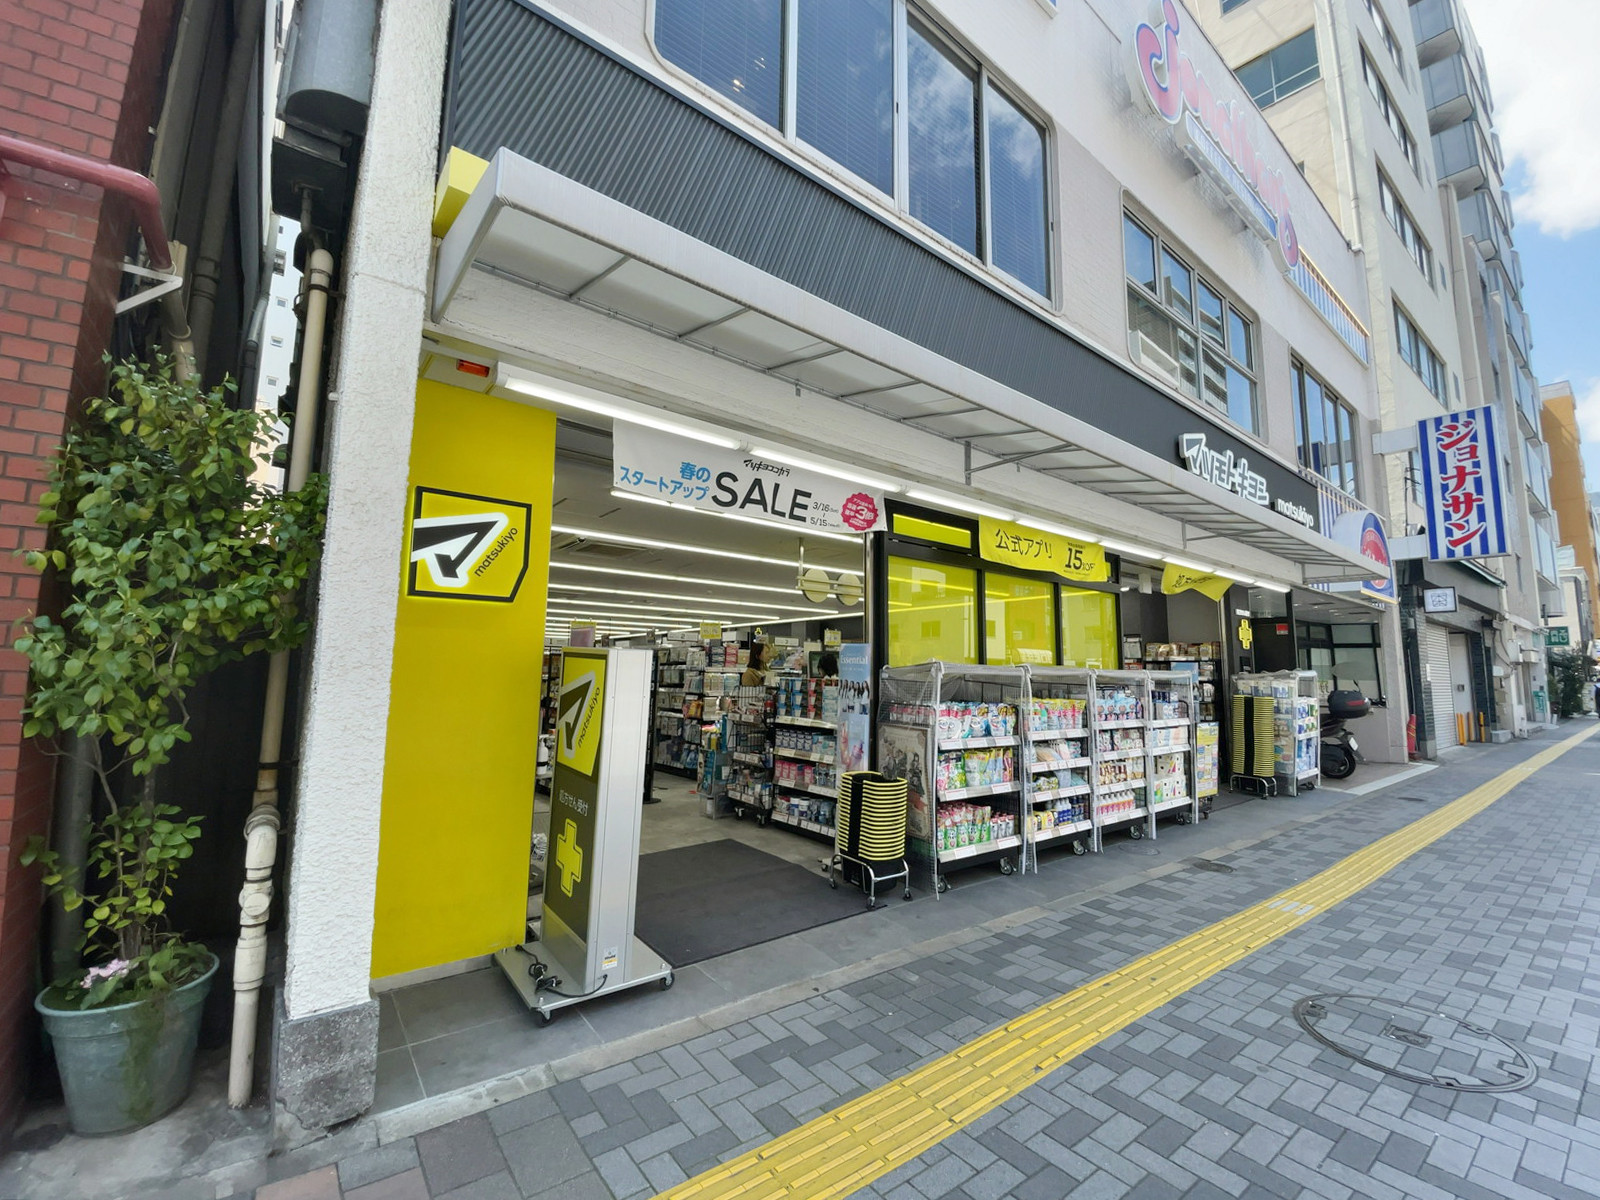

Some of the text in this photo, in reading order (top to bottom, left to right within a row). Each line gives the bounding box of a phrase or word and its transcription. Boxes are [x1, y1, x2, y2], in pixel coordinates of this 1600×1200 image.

[619, 466, 711, 501] スタートアップ
[679, 461, 711, 483] 春の
[1437, 419, 1486, 549] ジョナサン
[711, 471, 812, 523] SALE
[812, 501, 830, 512] 3/16
[1276, 498, 1315, 529] matsukiyo
[809, 516, 828, 527] 5/15
[474, 526, 519, 578] matsukiyo
[994, 528, 1053, 559] 公式アプリ
[577, 686, 601, 749] matsukiyo
